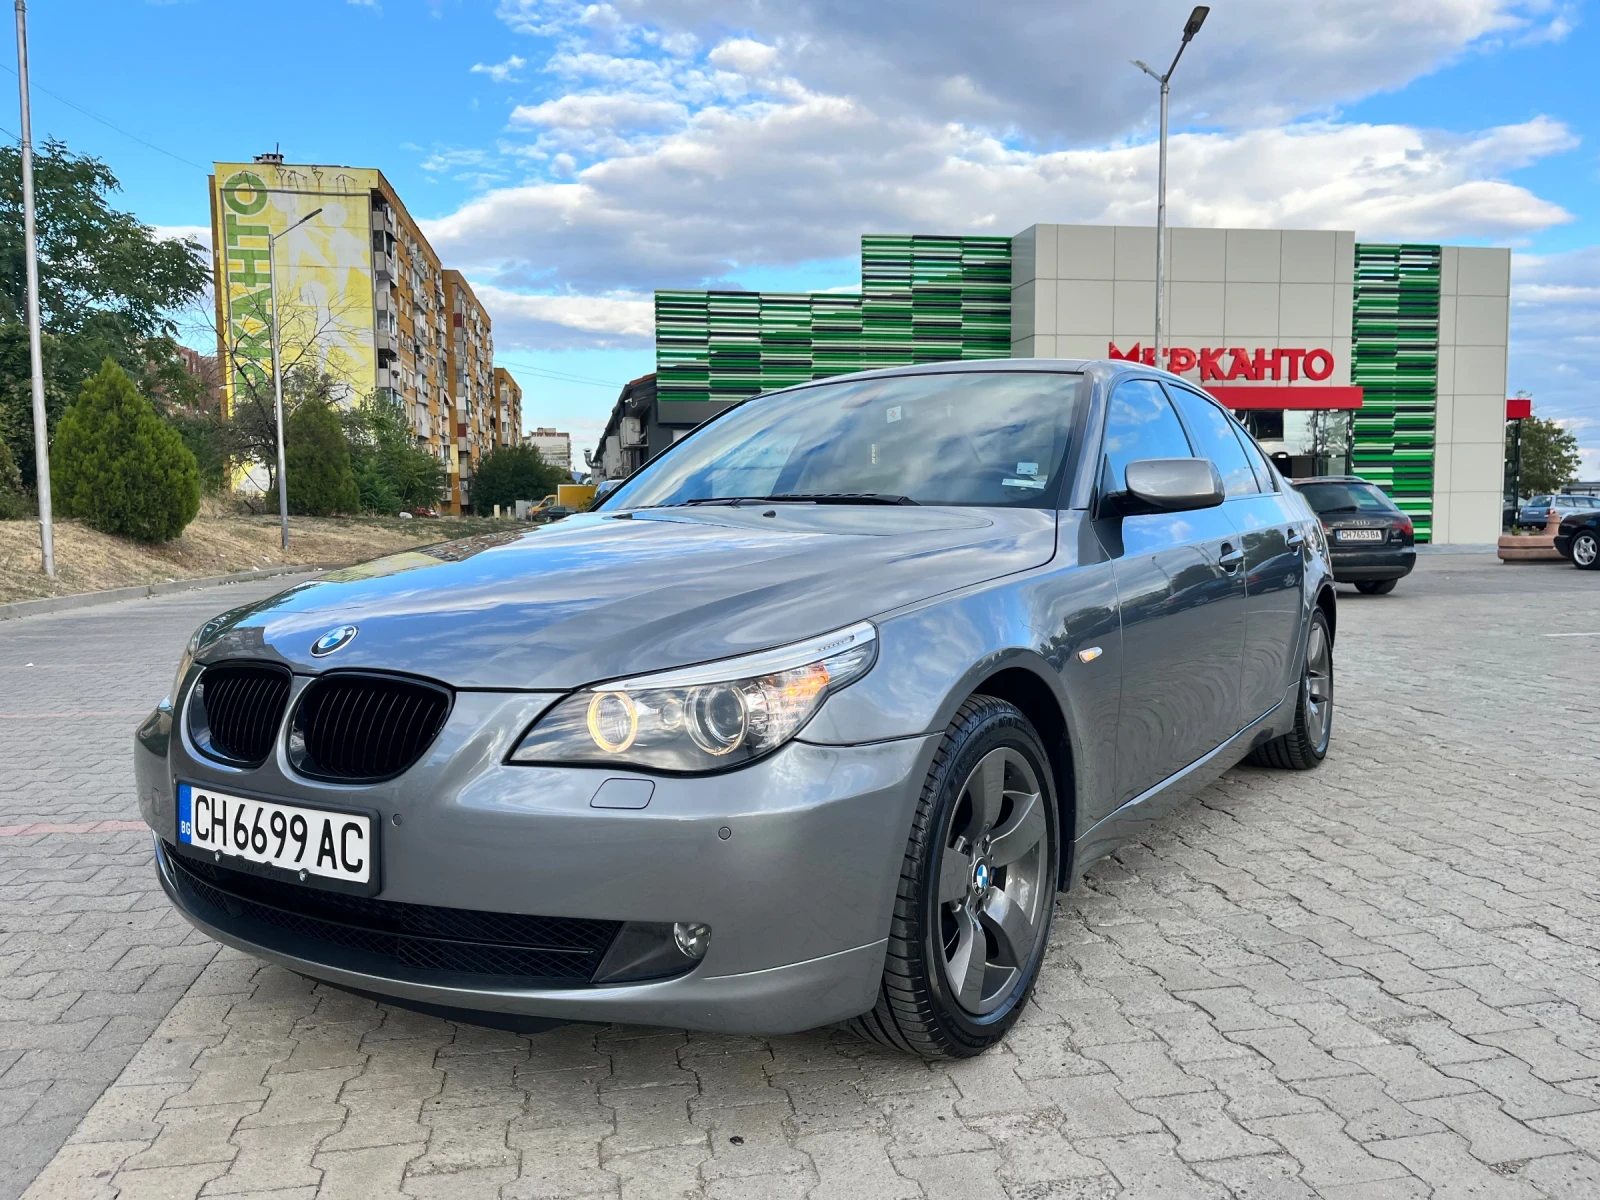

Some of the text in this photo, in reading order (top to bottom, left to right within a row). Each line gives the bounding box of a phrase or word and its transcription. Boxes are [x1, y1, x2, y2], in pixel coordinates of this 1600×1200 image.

[1341, 531, 1380, 539] CH 7653 BA
[181, 820, 191, 835] BG
[195, 794, 363, 873] CH 6699 AC
